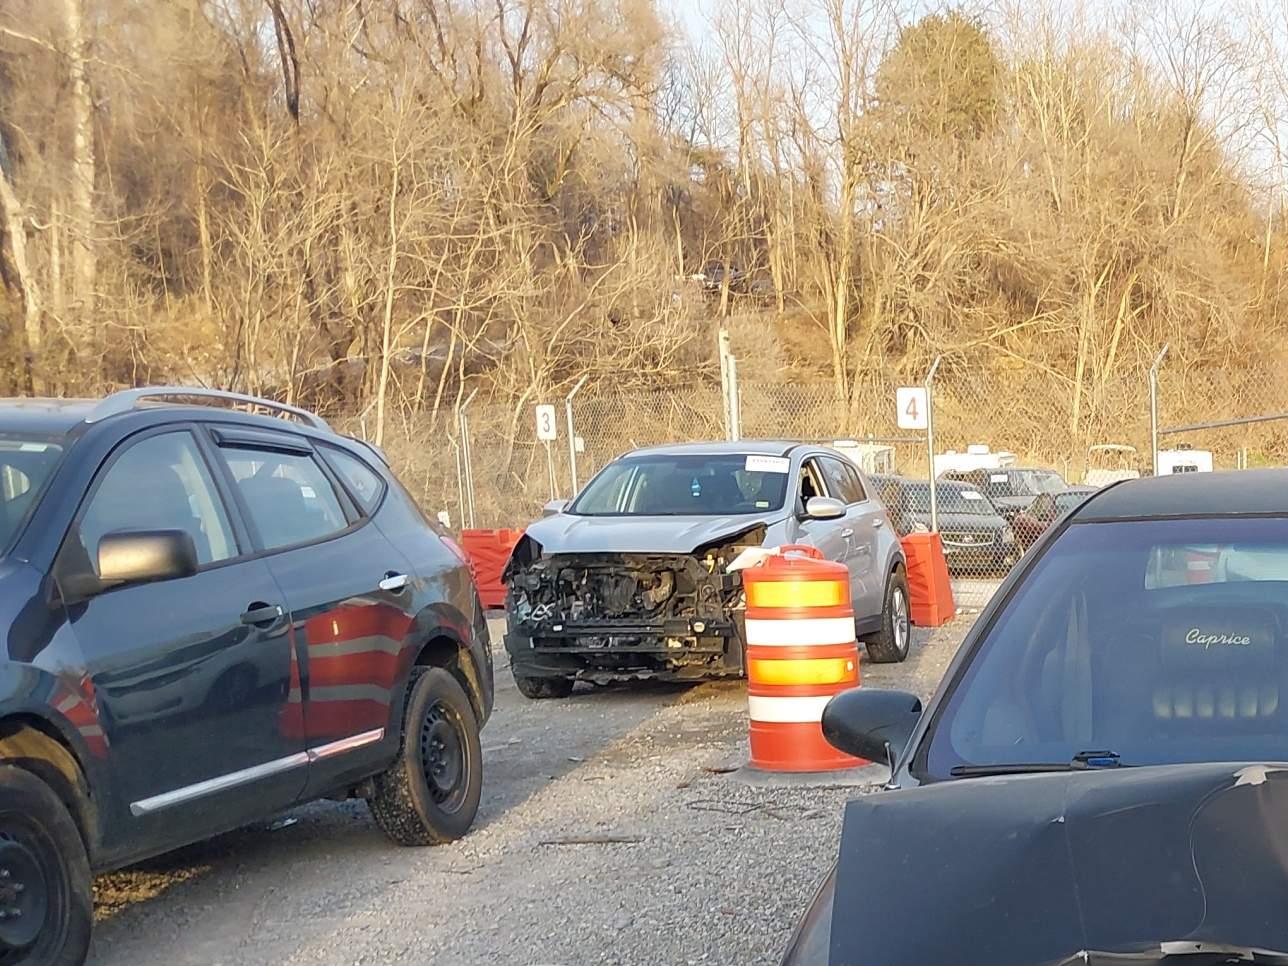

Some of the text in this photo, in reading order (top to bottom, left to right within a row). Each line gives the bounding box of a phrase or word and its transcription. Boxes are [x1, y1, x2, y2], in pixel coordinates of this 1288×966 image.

[905, 396, 919, 421] 4
[542, 411, 551, 433] 3
[1185, 628, 1251, 649] Caprice
